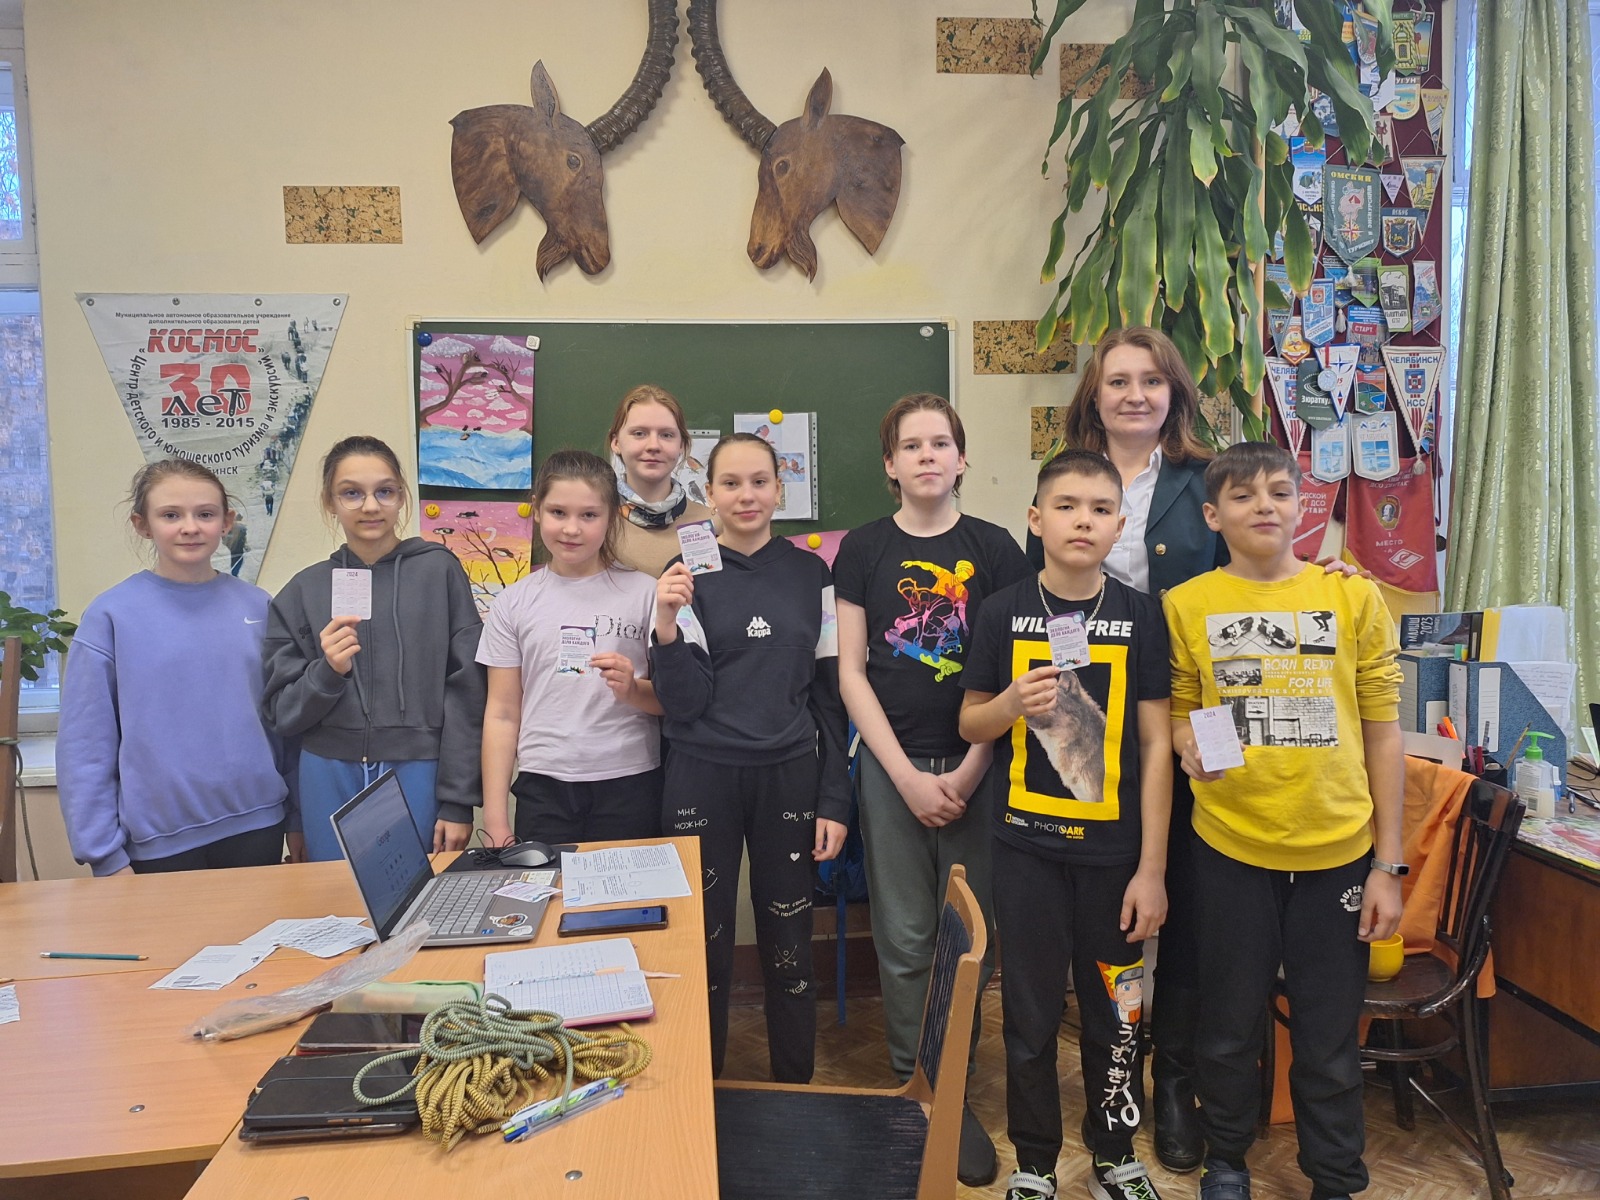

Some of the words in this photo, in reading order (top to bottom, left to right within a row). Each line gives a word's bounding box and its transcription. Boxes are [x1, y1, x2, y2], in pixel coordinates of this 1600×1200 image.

[1391, 356, 1439, 364] ЧЕЛЯБИНСК
[125, 354, 147, 390] Центр
[258, 354, 281, 412] экскурсий
[1406, 398, 1426, 407] КСС
[126, 392, 157, 439] детского
[264, 413, 275, 422] и
[161, 418, 201, 428] 1985
[216, 418, 255, 428] 2015
[155, 437, 163, 447] и
[233, 424, 269, 458] туризма
[1011, 616, 1048, 633] WIL
[1087, 620, 1133, 638] FREE
[1420, 616, 1434, 635] 2023
[747, 628, 772, 638] Kappa
[1264, 658, 1298, 670] BORN
[1288, 678, 1314, 688] FOR
[677, 807, 697, 817] МНЕ
[803, 811, 815, 820] YES
[674, 818, 708, 830] МОЖНО
